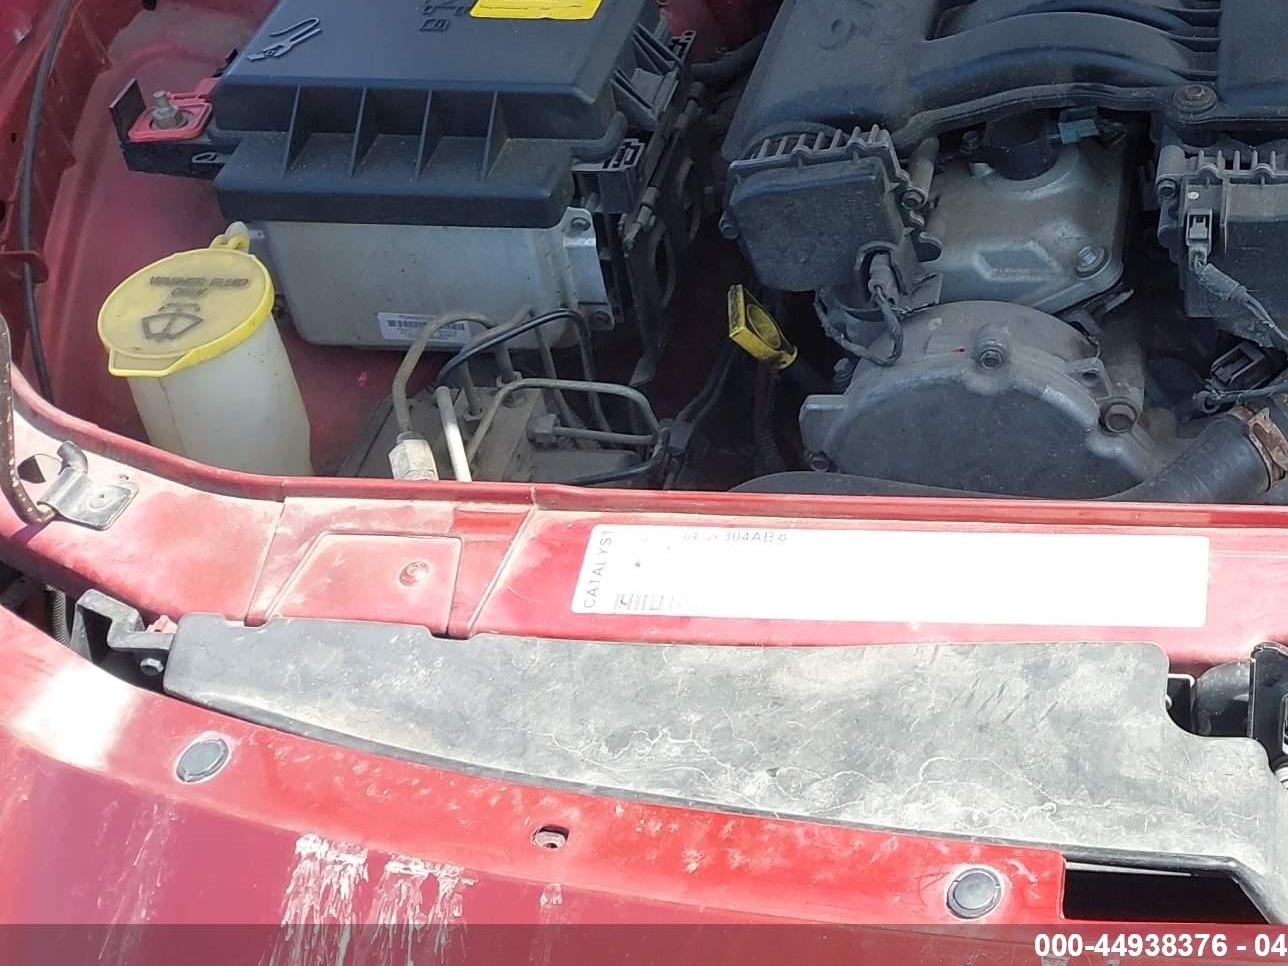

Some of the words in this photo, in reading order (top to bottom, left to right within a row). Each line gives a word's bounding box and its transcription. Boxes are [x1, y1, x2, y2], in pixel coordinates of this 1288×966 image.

[149, 276, 207, 287] WASHER
[208, 277, 250, 288] FLUID
[583, 530, 613, 610] CATALYST
